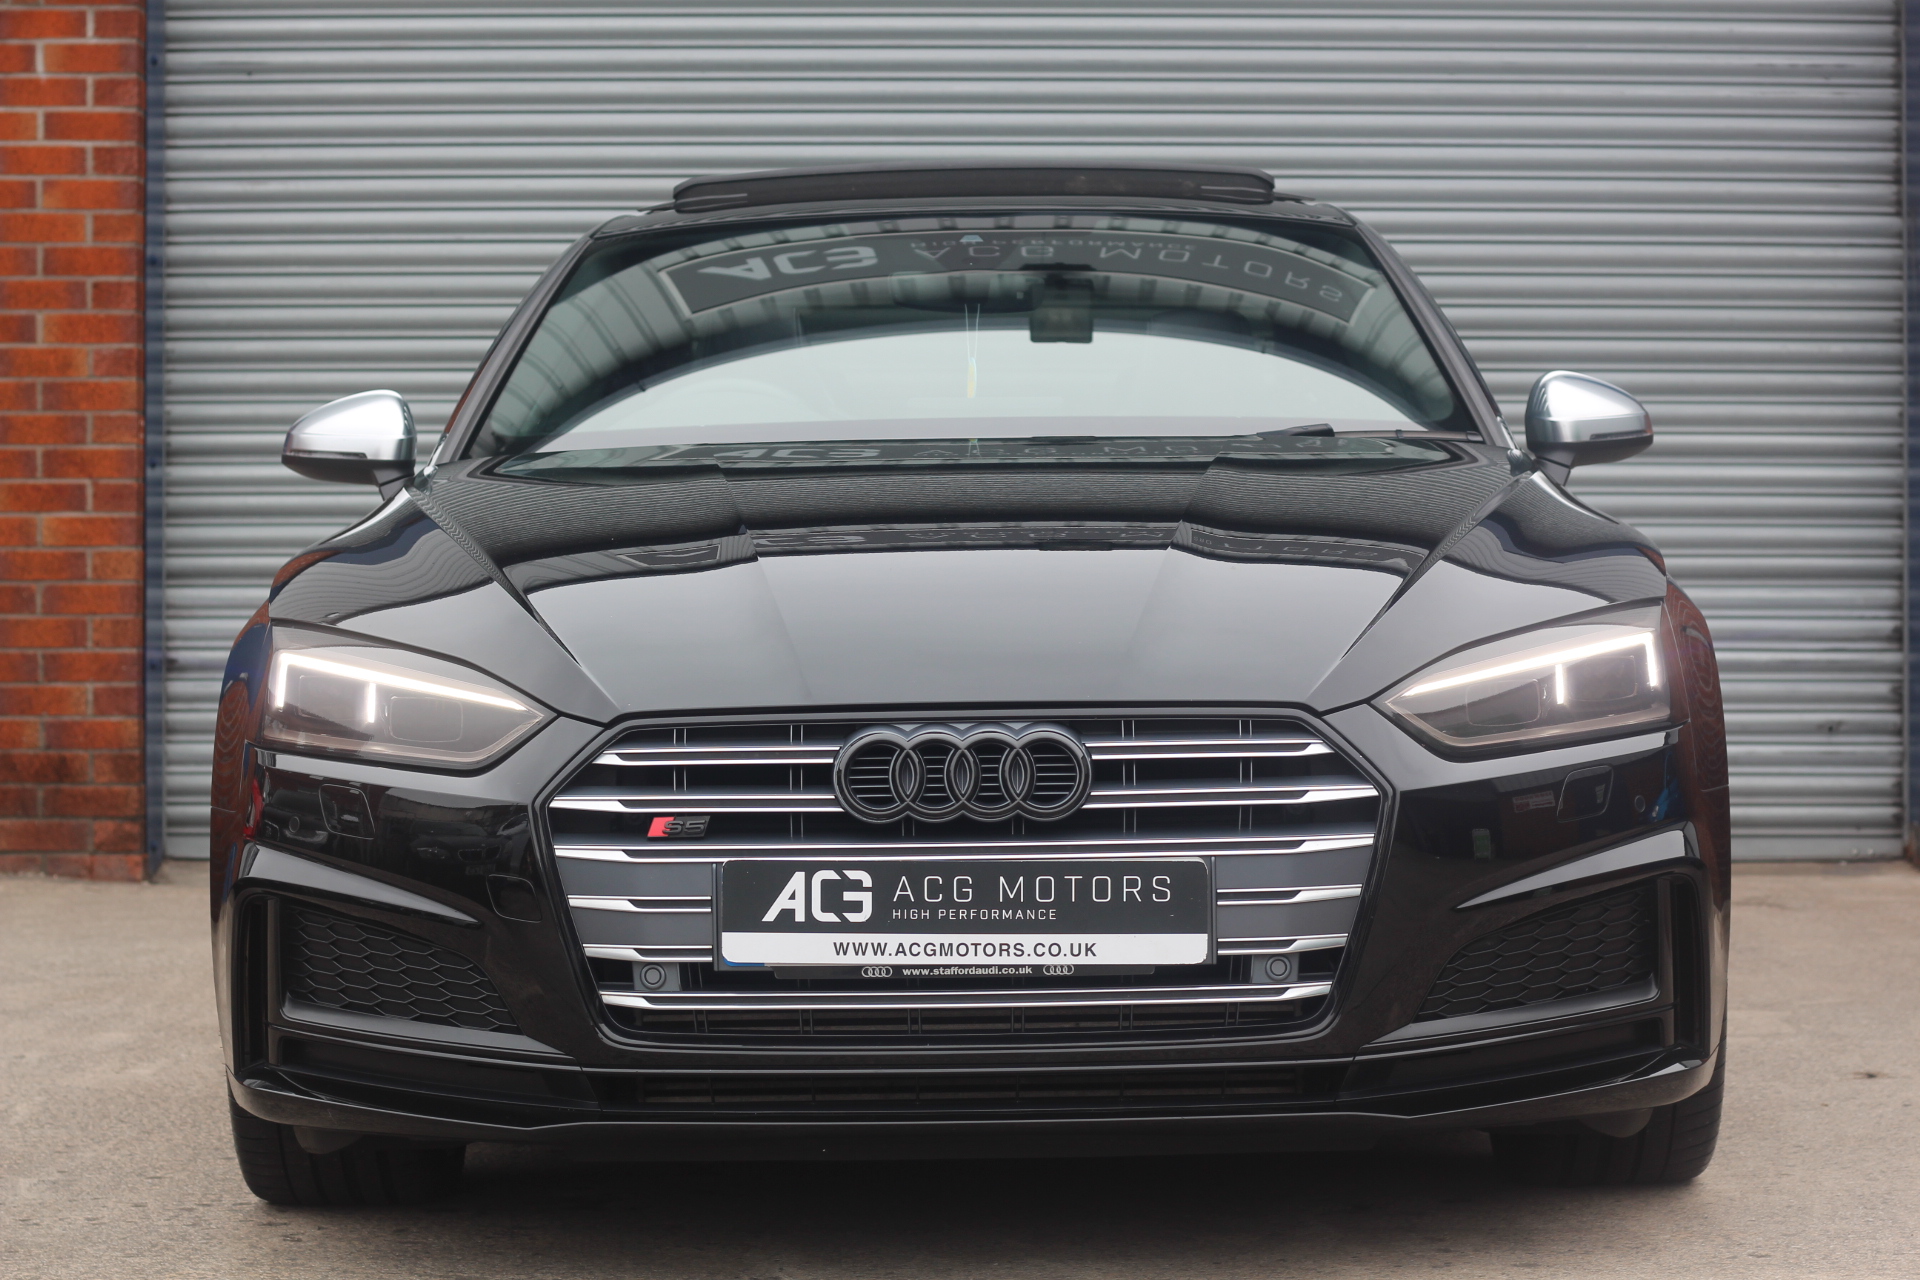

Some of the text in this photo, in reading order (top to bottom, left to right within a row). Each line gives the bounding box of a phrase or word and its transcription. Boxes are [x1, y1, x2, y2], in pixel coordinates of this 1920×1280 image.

[662, 820, 706, 835] S5
[761, 869, 873, 923] ACG
[893, 875, 1171, 903] ACG MOTORS
[892, 908, 1057, 920] HIGH PERFORMANCE
[833, 941, 1097, 958] WWW.ACGMOTORS.CO.UK
[902, 965, 1033, 977] www.staffordaudi.co.uk
